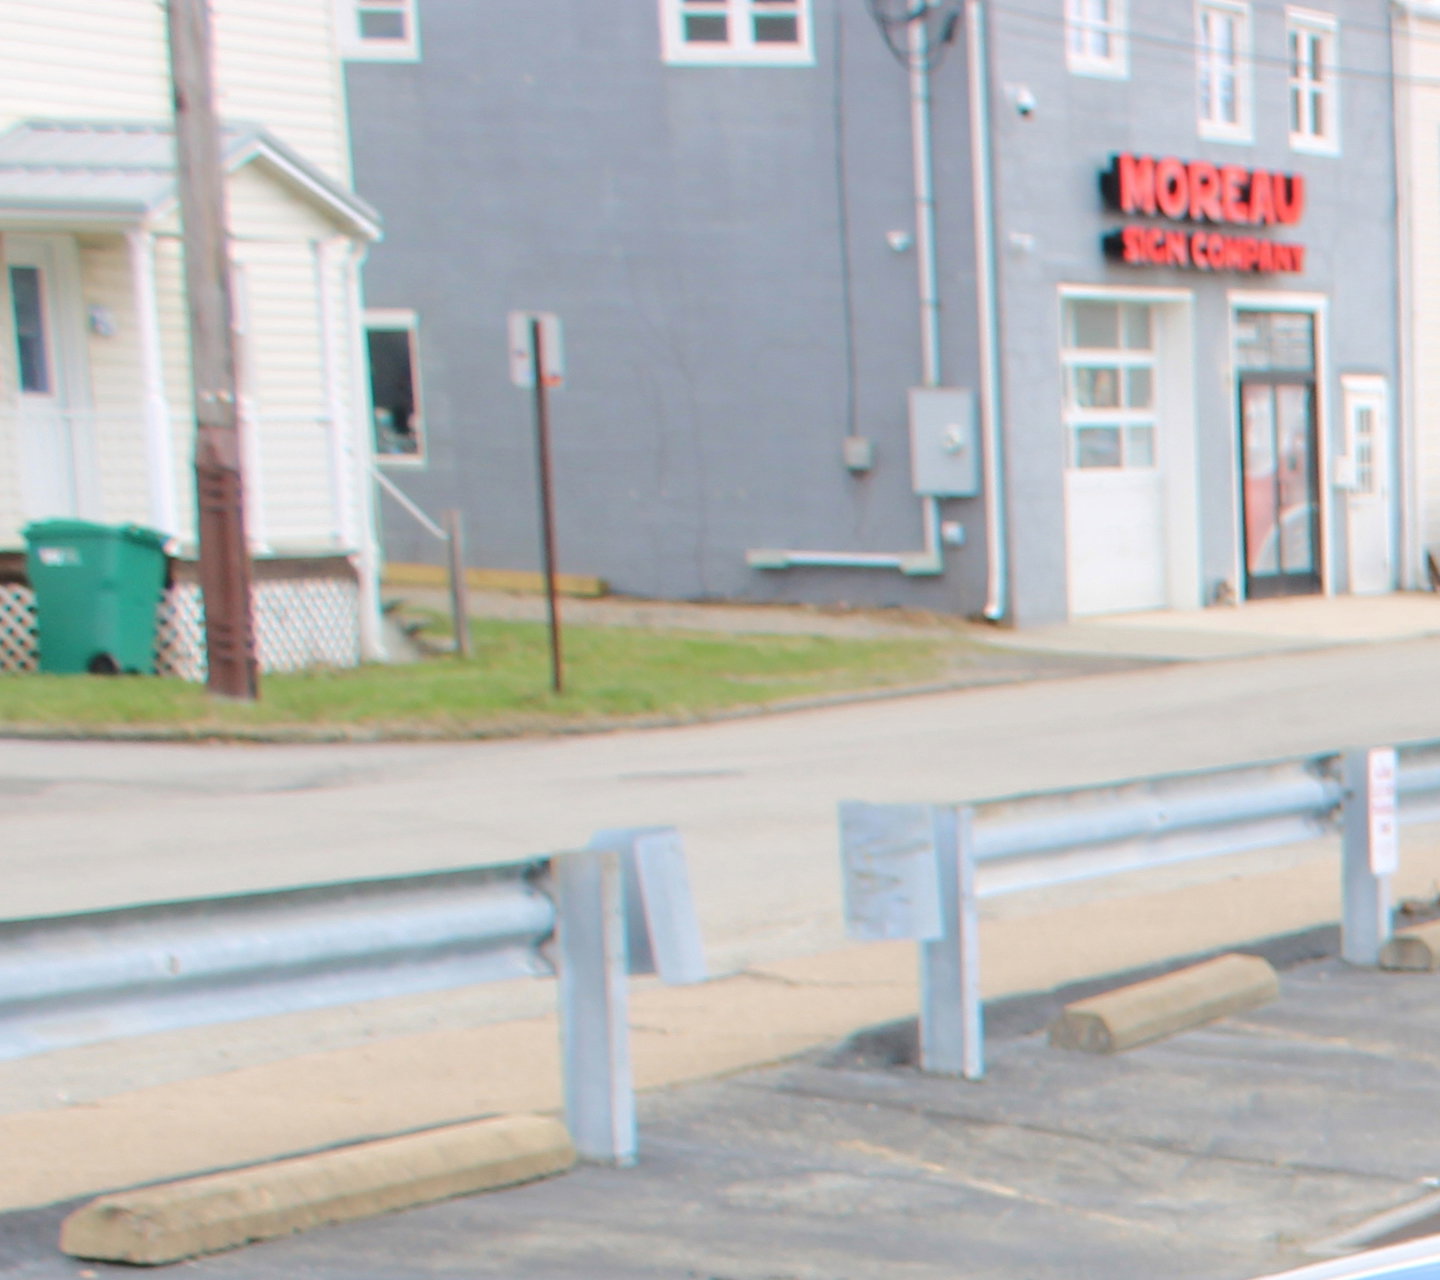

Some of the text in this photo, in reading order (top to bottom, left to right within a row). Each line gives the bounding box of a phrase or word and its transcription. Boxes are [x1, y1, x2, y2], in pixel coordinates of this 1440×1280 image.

[1119, 152, 1304, 224] MOREAU
[1123, 227, 1304, 272] SIGN COMPANY
